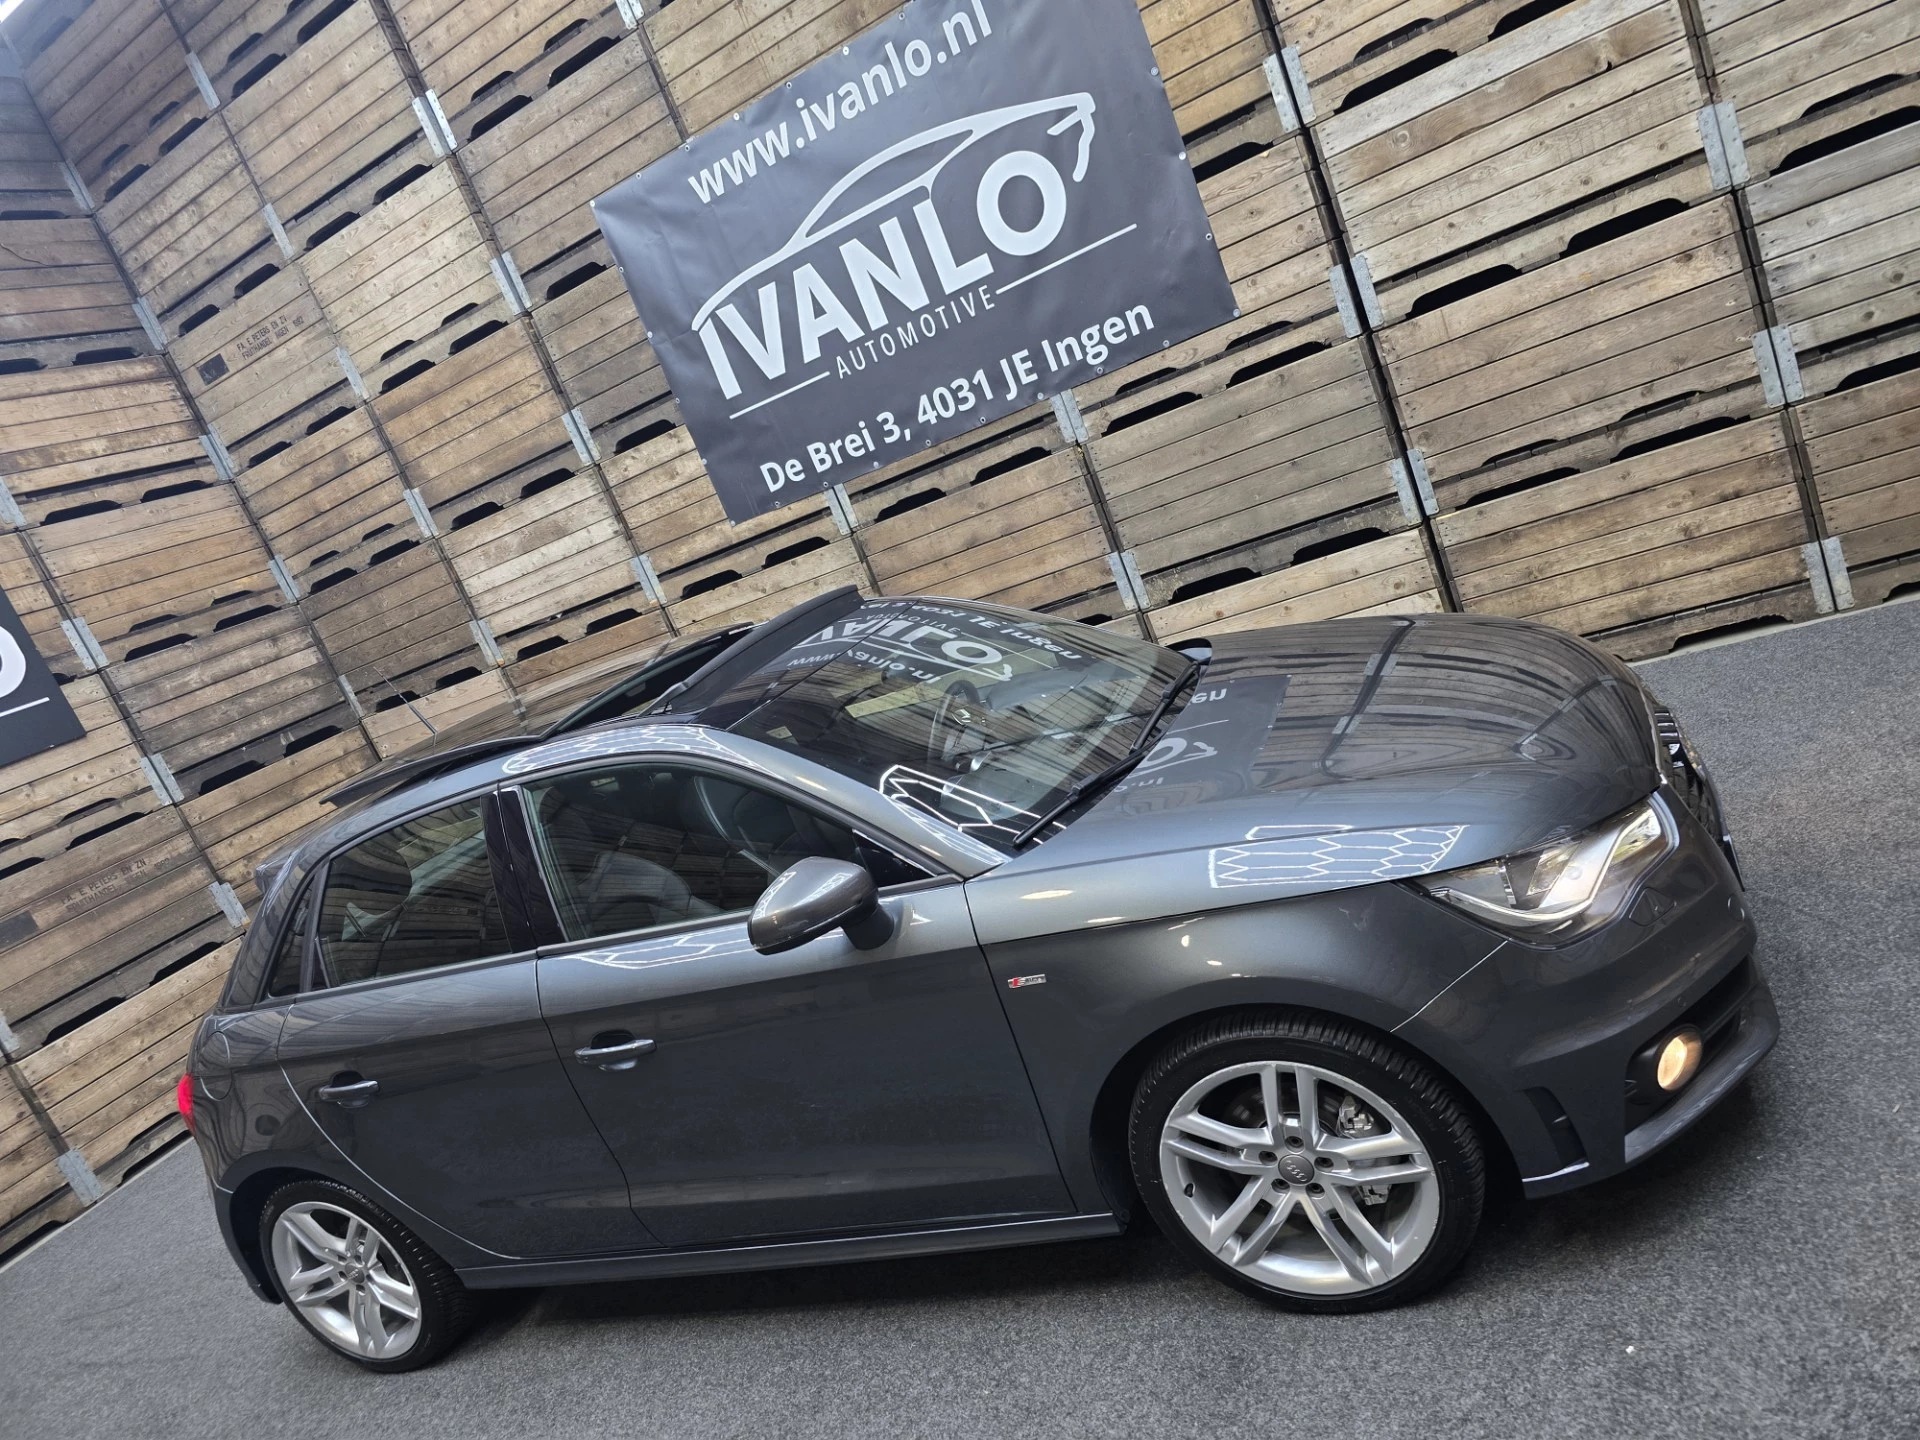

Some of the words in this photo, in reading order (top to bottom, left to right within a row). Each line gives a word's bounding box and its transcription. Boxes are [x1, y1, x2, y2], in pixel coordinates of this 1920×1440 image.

[687, 0, 993, 204] www.ivanlo.nl
[698, 150, 1067, 400] IVANLO
[836, 284, 996, 379] AUTOMOTIVE
[759, 458, 806, 493] De
[806, 420, 877, 473] Brei
[876, 411, 912, 444] 3,
[917, 368, 994, 425] 4031
[1000, 348, 1039, 401] JE
[1041, 304, 1155, 372] Ingen
[88, 872, 118, 891] PETERS
